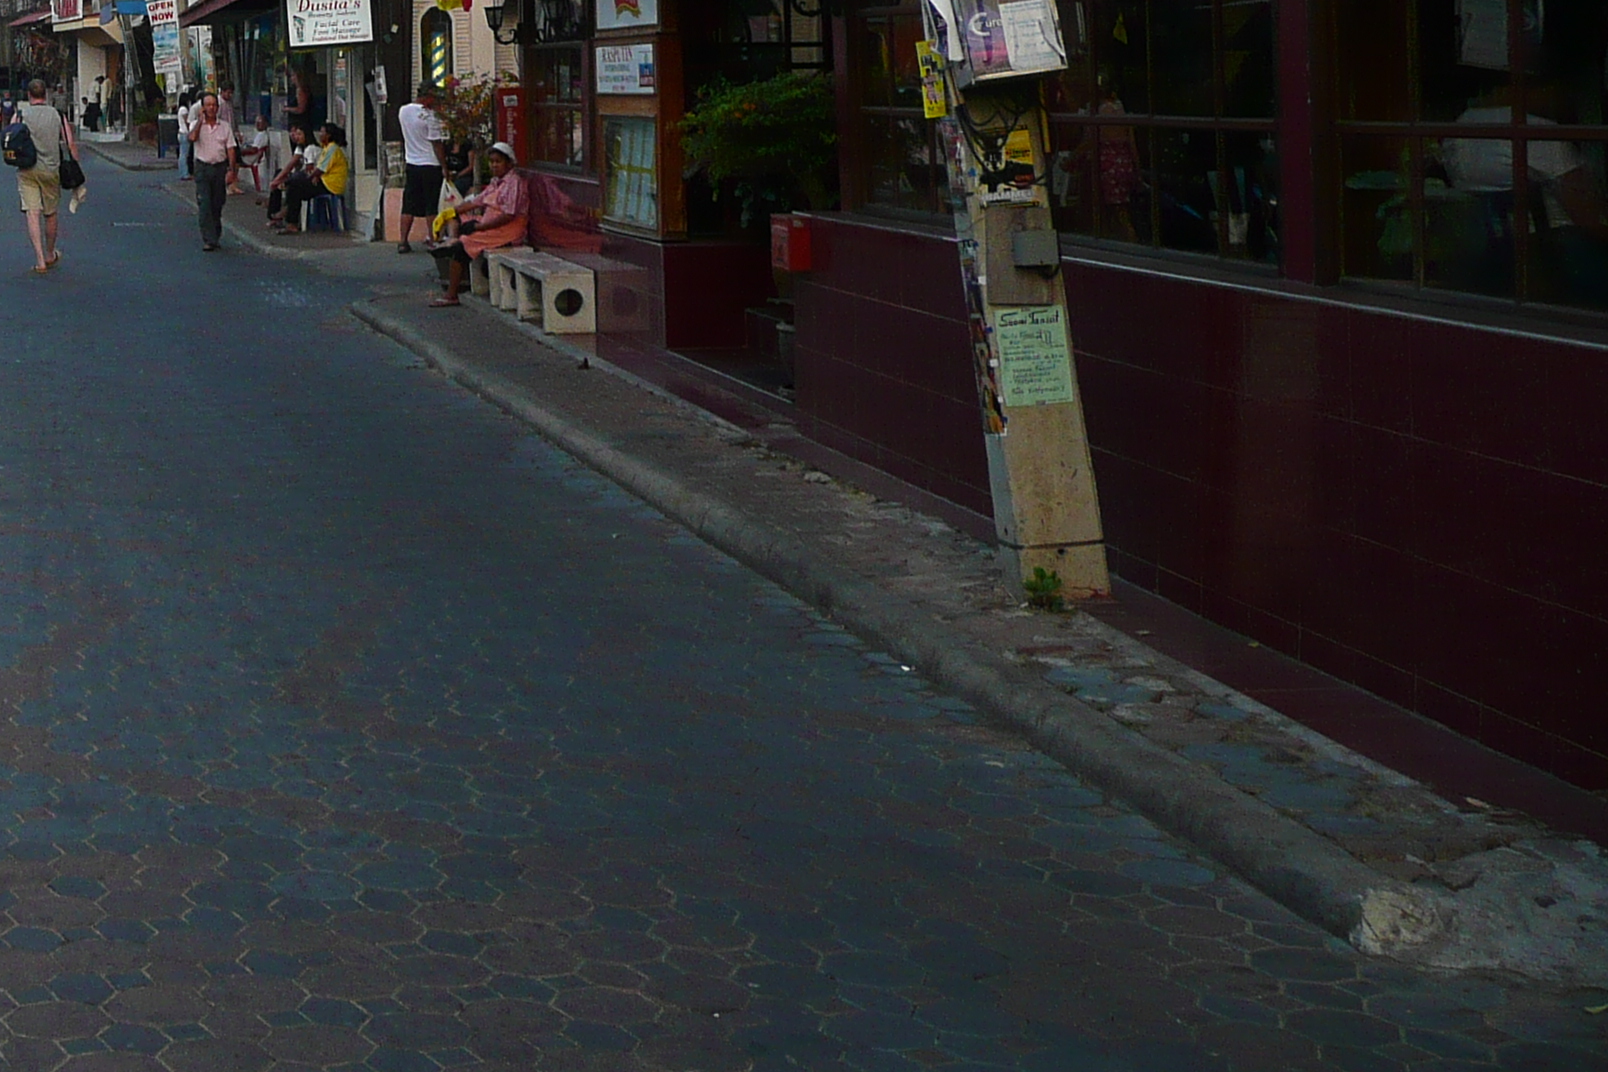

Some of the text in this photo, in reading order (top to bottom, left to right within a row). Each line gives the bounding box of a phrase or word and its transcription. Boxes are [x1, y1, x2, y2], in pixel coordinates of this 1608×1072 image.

[148, 1, 173, 12] OPEN
[151, 12, 173, 23] NOW
[342, 18, 361, 26] Care
